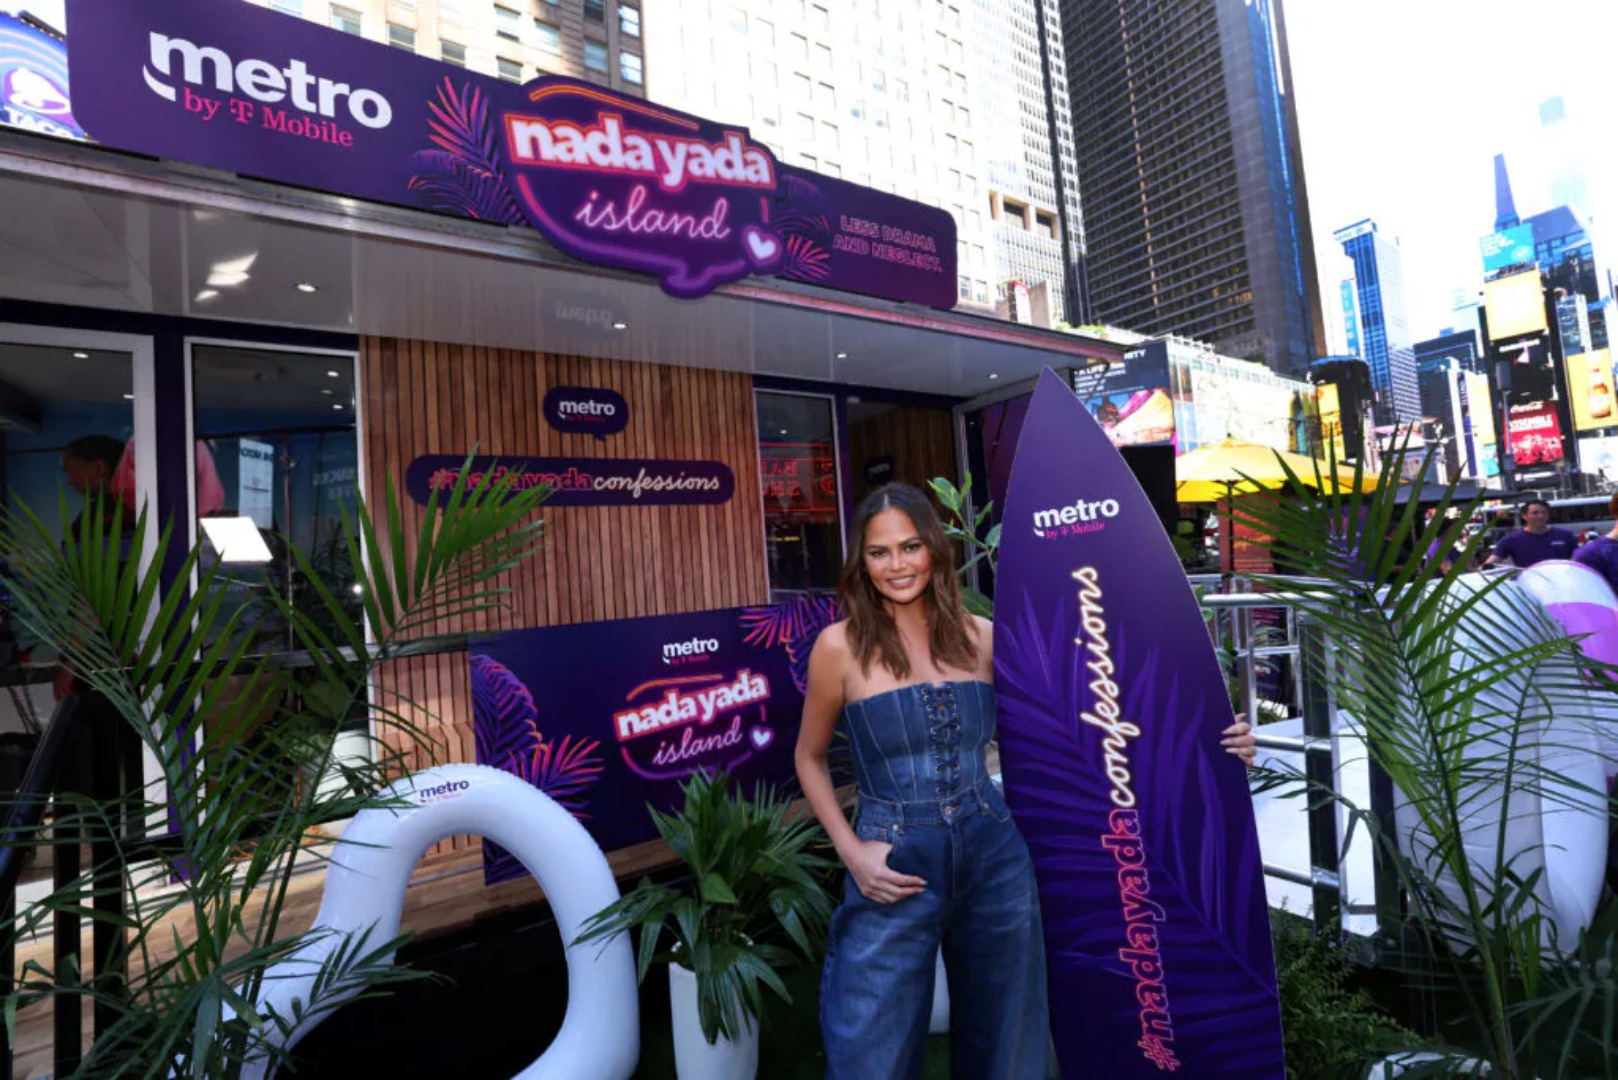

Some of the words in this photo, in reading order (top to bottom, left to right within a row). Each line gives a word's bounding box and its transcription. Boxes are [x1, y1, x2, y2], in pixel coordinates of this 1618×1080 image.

[143, 31, 393, 129] metro
[183, 87, 221, 121] by
[262, 105, 354, 148] Mobile
[574, 184, 732, 240] island
[832, 233, 871, 256] AND
[839, 214, 881, 239] LESS
[881, 224, 938, 254] DRAMA
[557, 399, 616, 420] metro
[1032, 498, 1120, 537] metro
[662, 636, 720, 665] metro
[651, 713, 744, 766] island
[419, 779, 470, 803] metro
